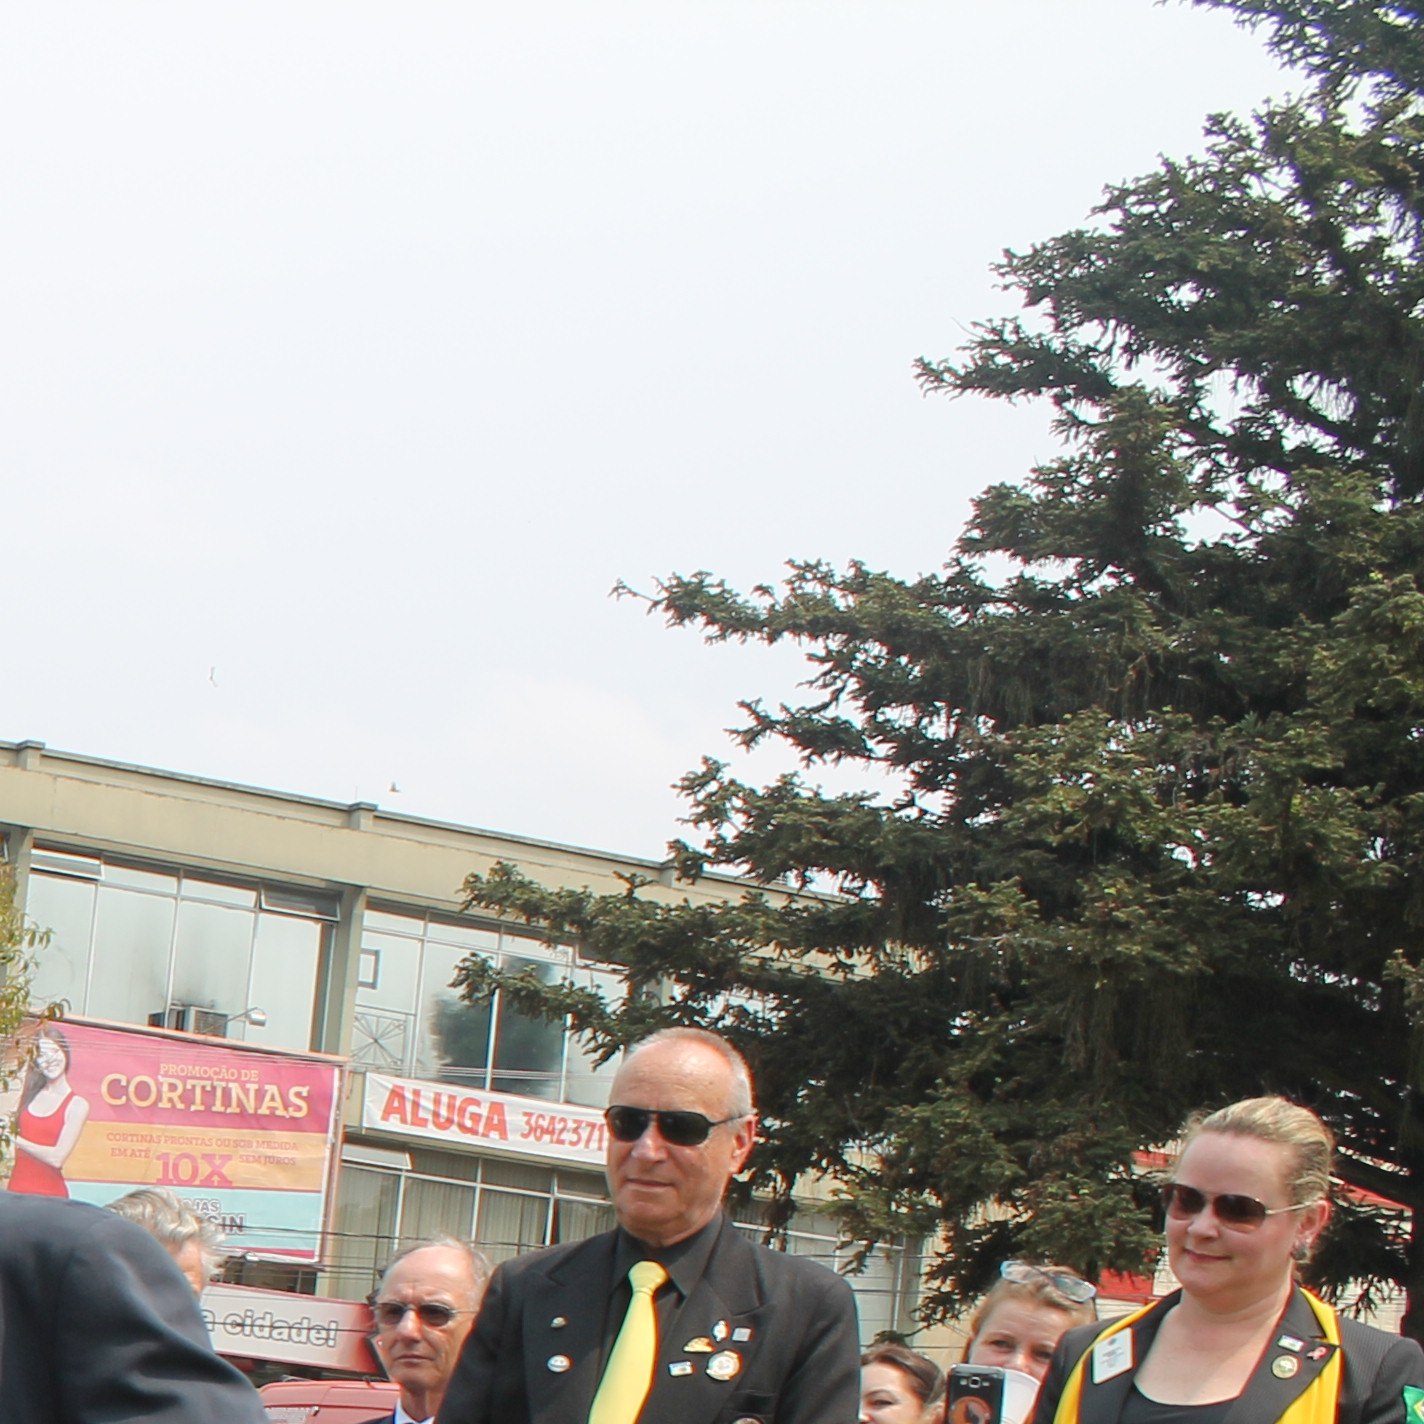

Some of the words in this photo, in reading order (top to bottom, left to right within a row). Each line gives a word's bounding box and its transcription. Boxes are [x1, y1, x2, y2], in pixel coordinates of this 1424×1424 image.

[159, 1063, 238, 1081] PROMOÇÃO
[241, 1070, 259, 1082] DE
[101, 1073, 310, 1118] CORTINAS
[380, 1084, 509, 1140] ALUGA
[106, 1133, 161, 1144] CORTINAS
[163, 1136, 213, 1147] PRONTAS
[215, 1138, 231, 1148] OU
[232, 1139, 252, 1149] SOB
[255, 1140, 298, 1151] MEDIDA
[110, 1148, 128, 1158] EM
[129, 1147, 151, 1159] ATÉ
[154, 1152, 233, 1187] 10X
[239, 1154, 261, 1165] SEM
[262, 1156, 297, 1167] JUROS
[223, 1309, 338, 1348] cidade!
